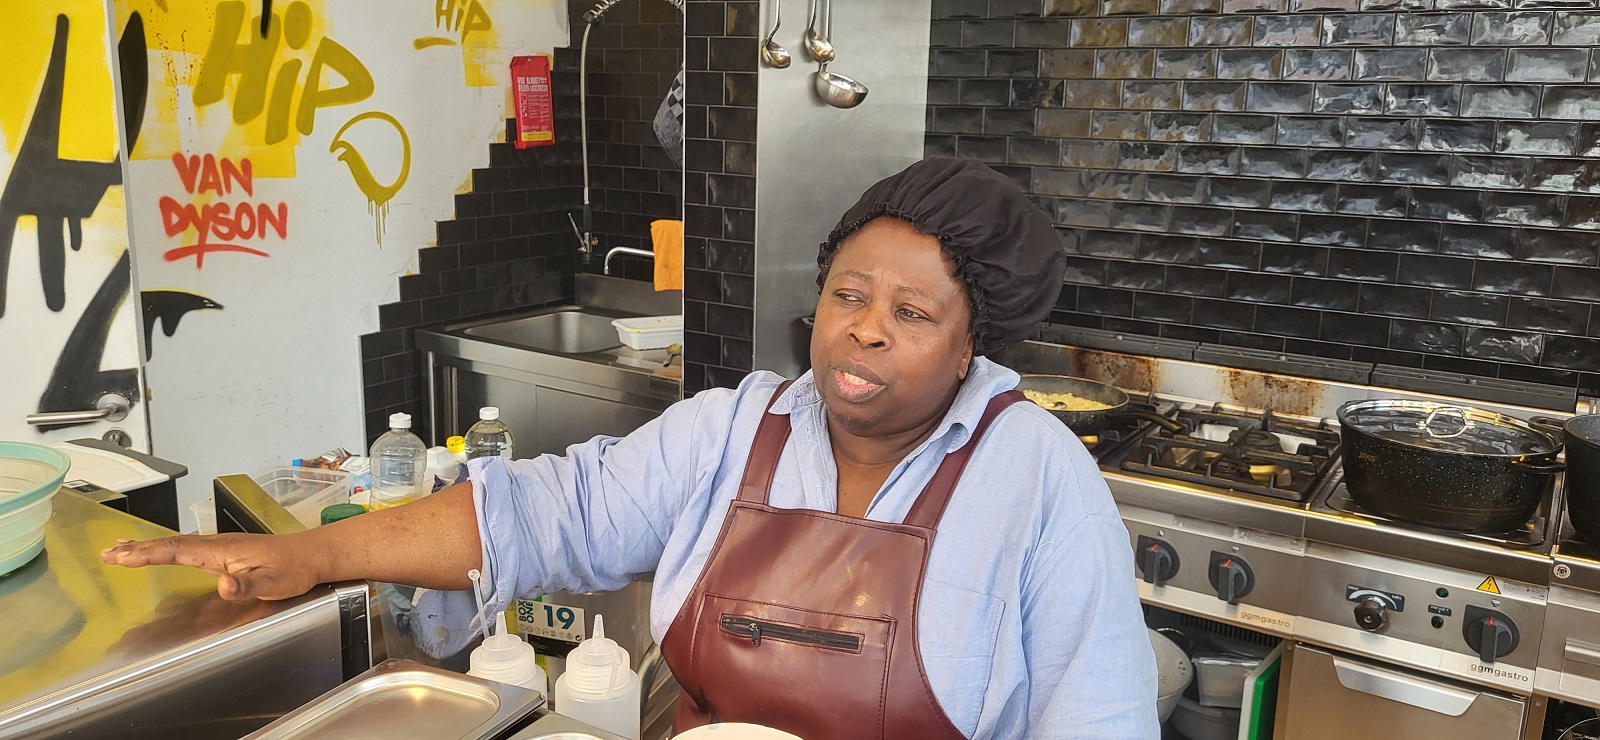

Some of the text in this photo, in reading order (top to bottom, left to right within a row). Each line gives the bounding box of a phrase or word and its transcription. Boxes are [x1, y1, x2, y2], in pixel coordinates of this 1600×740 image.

[172, 152, 254, 197] VAN
[518, 600, 527, 621] BOX
[525, 601, 534, 623] ONE
[544, 605, 575, 629] 19
[1240, 611, 1291, 628] ggmgastro
[1470, 662, 1529, 682] ggmgastro
